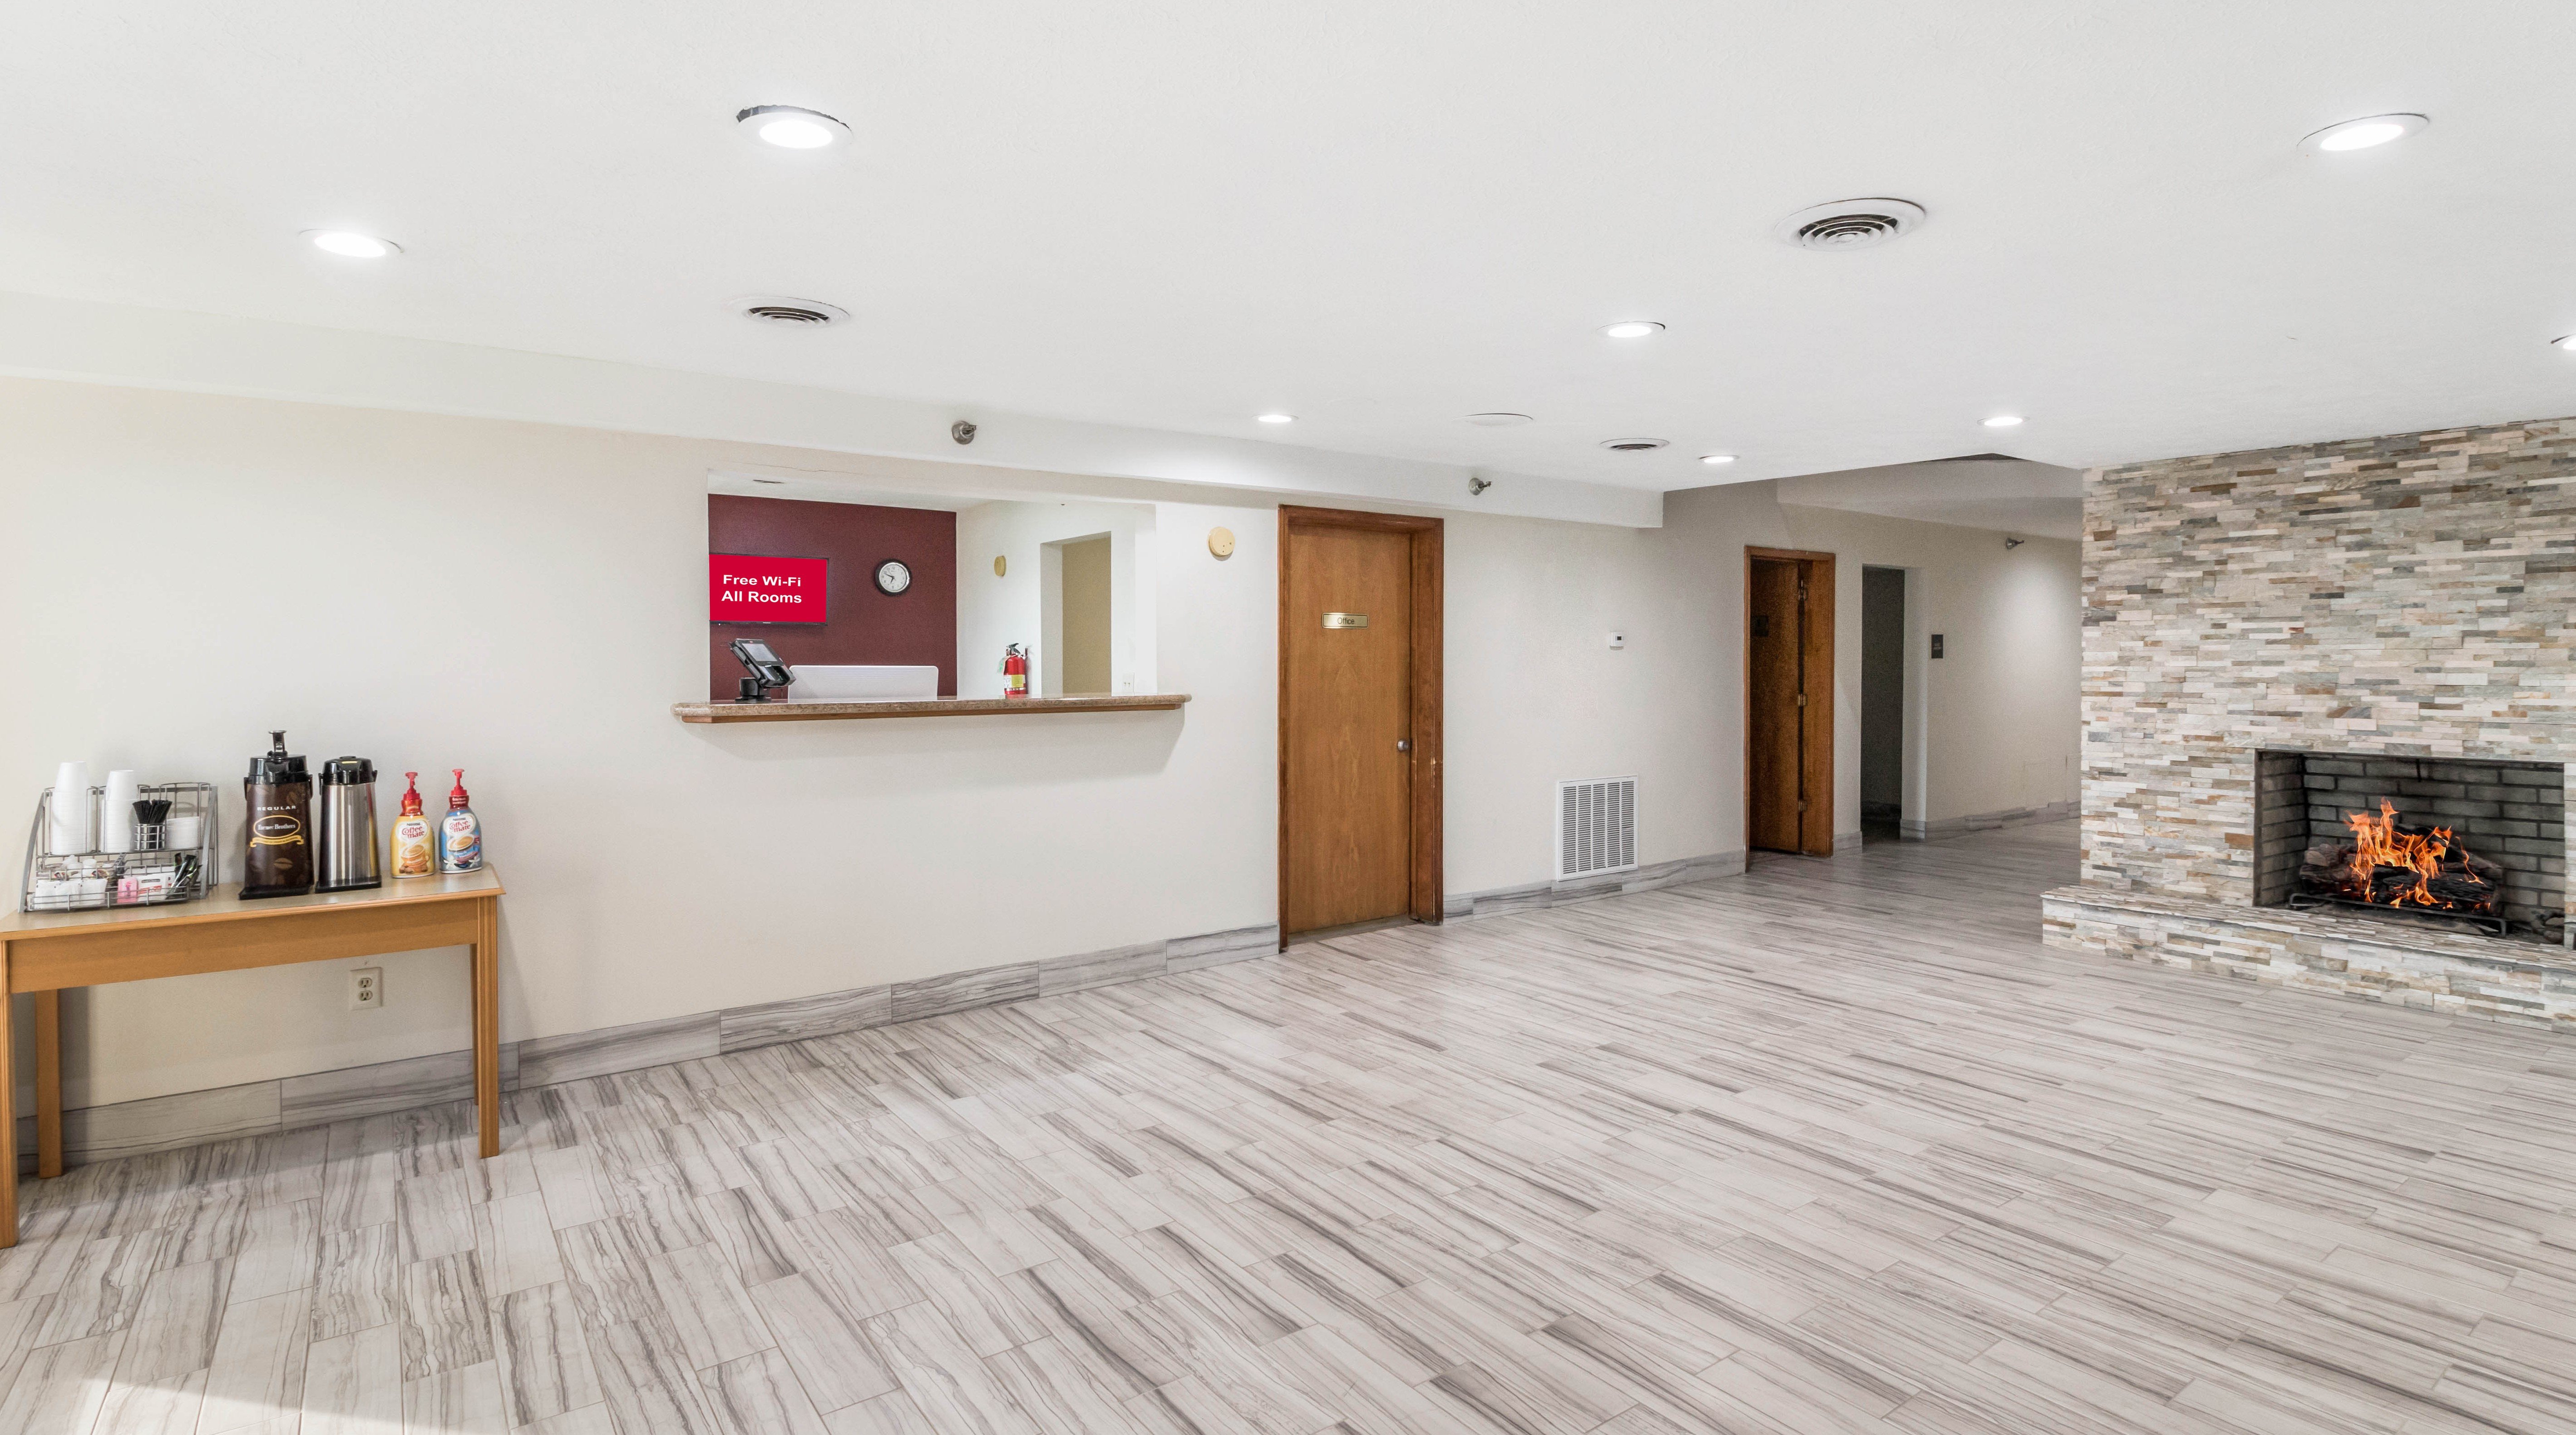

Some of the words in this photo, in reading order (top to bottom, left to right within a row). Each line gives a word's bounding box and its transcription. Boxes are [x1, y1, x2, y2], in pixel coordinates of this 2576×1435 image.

[723, 574, 757, 585] Free
[762, 576, 801, 587] Wi-Fi
[721, 590, 742, 602] All
[748, 591, 802, 603] Rooms
